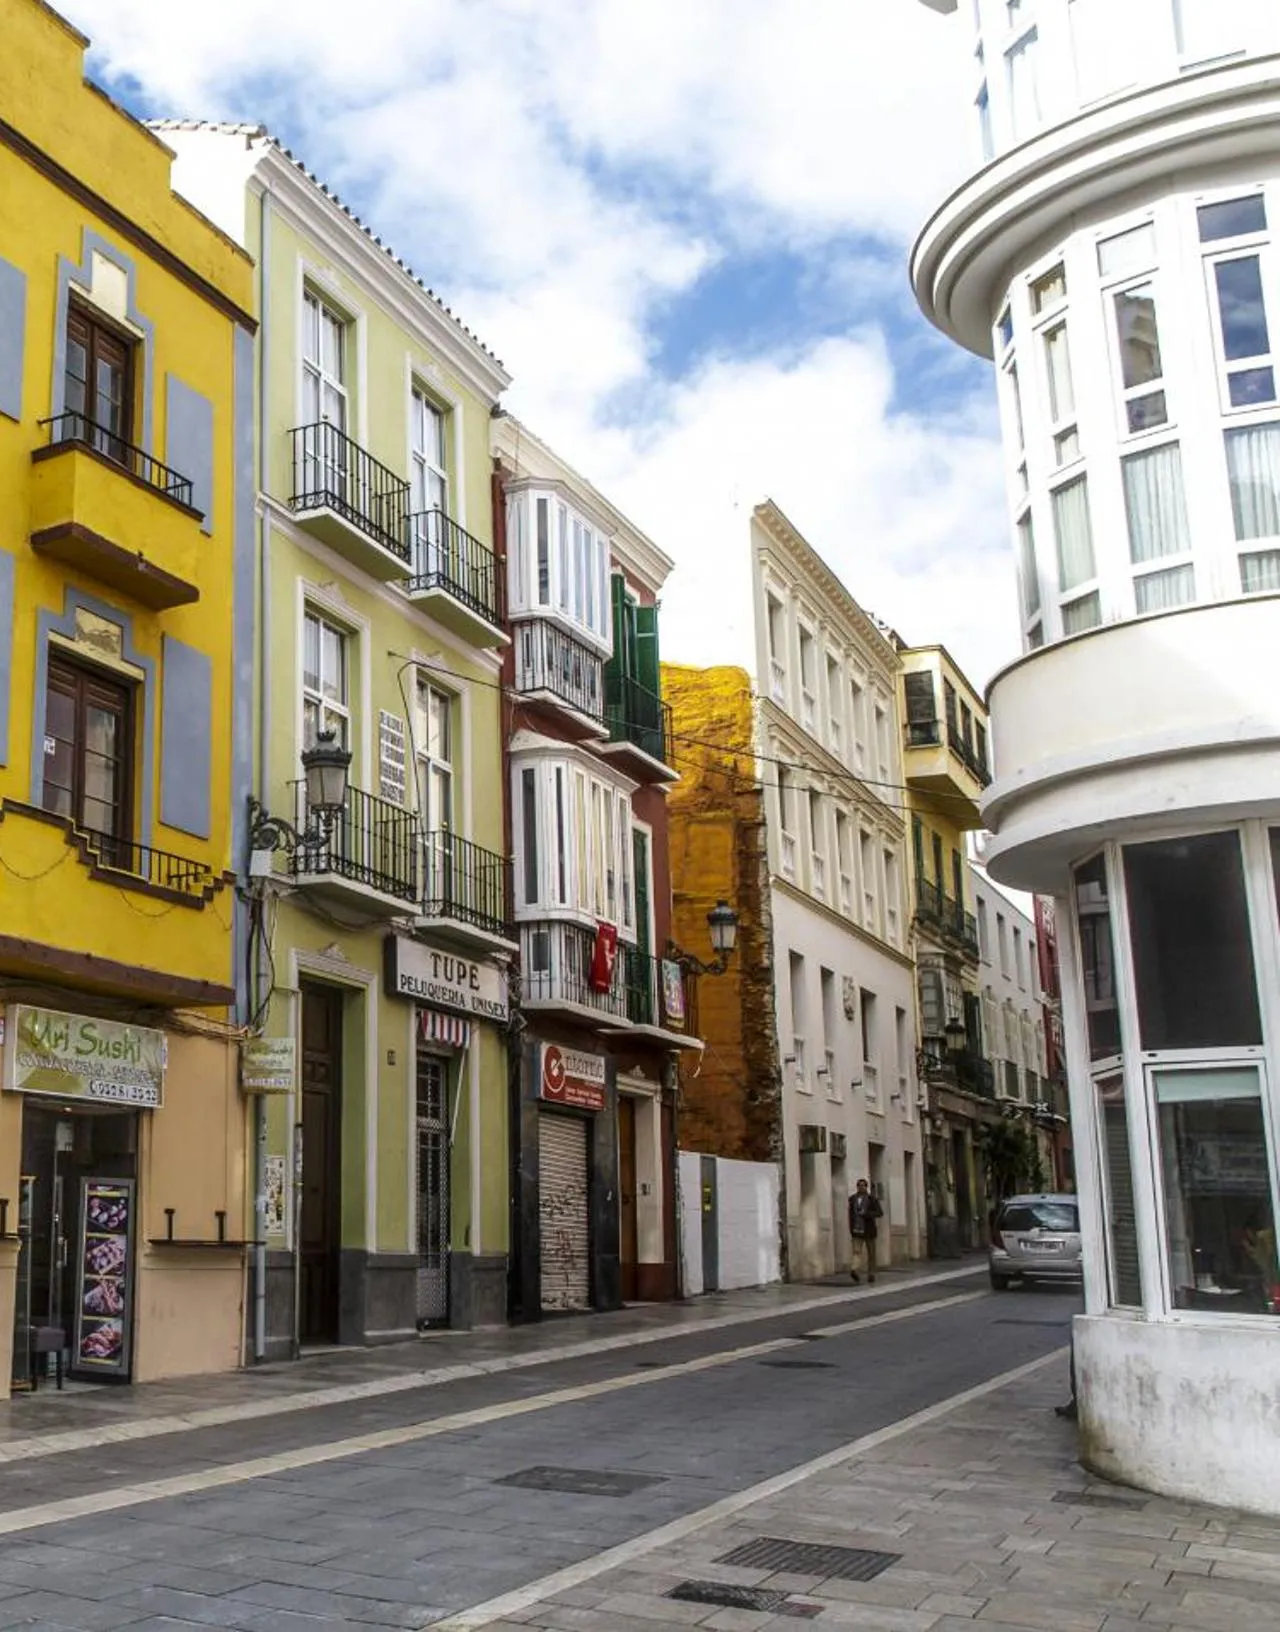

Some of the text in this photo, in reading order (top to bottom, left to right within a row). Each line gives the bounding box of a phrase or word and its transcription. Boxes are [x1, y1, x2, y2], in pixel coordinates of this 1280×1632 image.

[430, 952, 480, 991] TUPE
[400, 974, 506, 1020] PELUQUERIA UNISEX
[75, 1022, 142, 1064] Sushi
